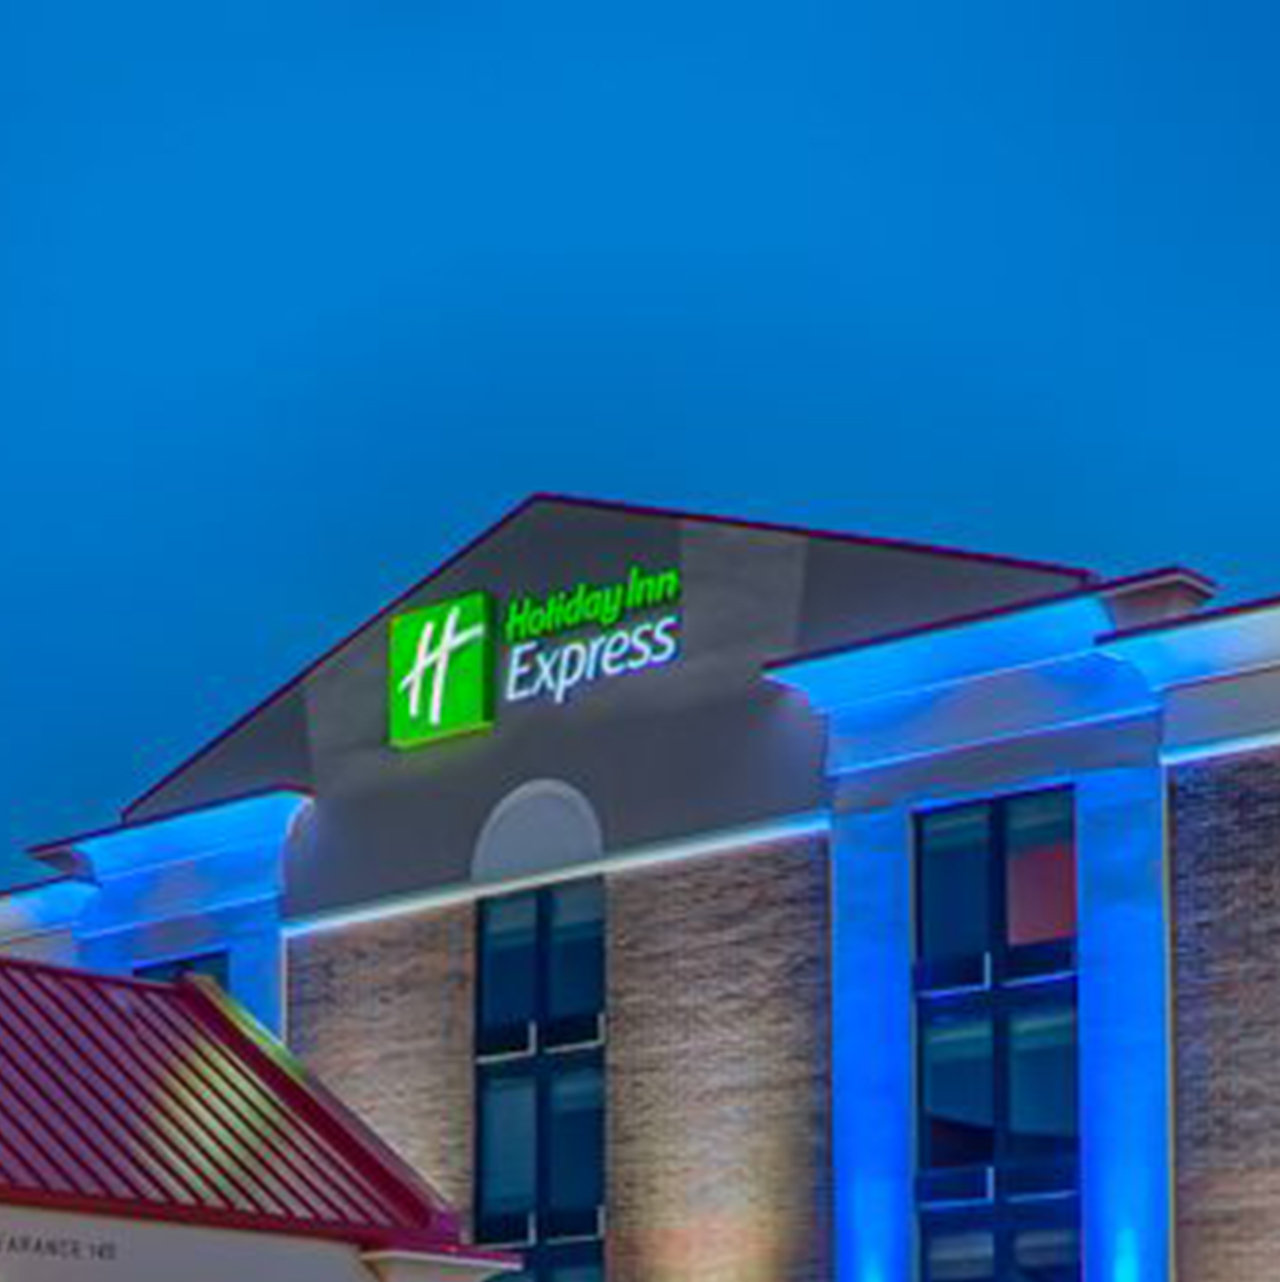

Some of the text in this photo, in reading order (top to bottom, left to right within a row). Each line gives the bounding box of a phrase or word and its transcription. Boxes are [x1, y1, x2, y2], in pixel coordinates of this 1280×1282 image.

[506, 566, 679, 639] Holiday Inn
[506, 616, 679, 702] Express
